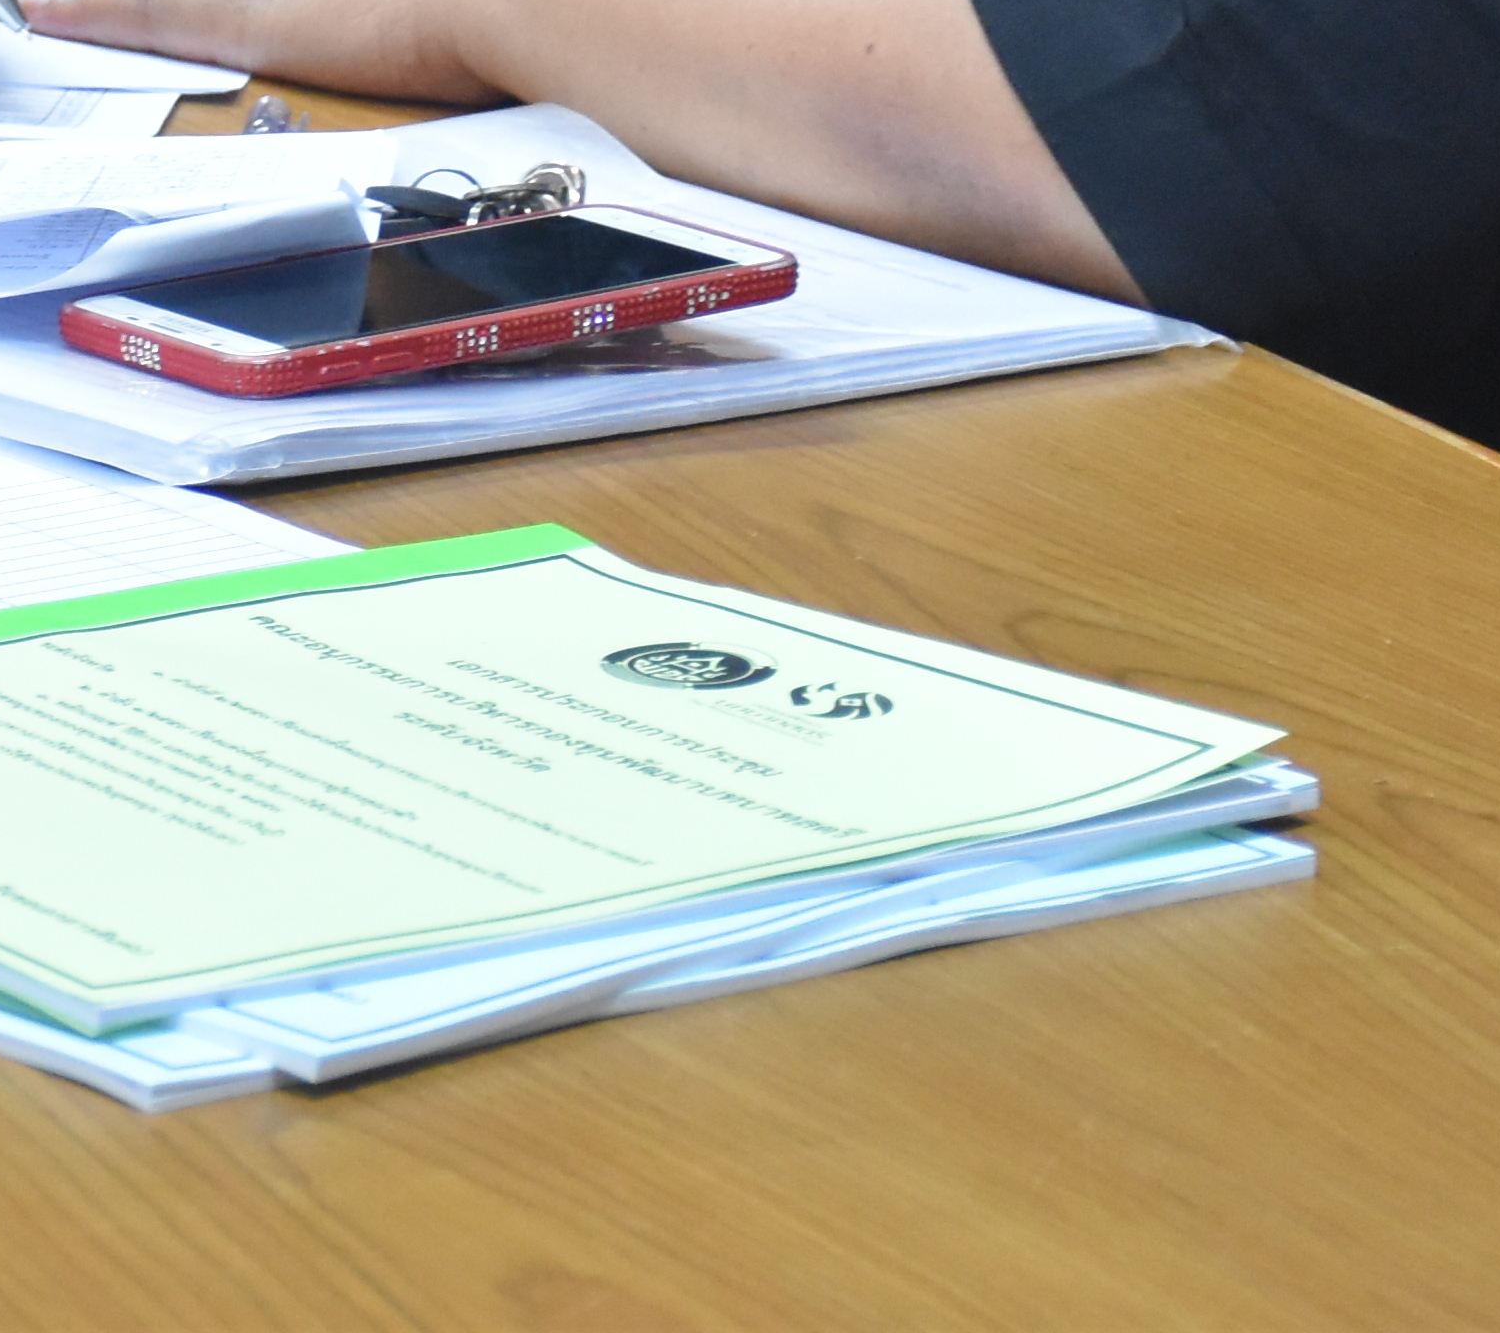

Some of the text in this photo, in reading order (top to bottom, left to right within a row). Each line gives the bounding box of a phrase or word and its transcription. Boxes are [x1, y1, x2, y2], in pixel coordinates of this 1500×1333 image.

[247, 614, 868, 839] คณะอนุกรรมการบริหารกองทุนพัฒนาบทบาทสตรี
[393, 709, 553, 774] ระดับจังหวัด
[445, 659, 784, 779] เอกสารประกอบการประชุม
